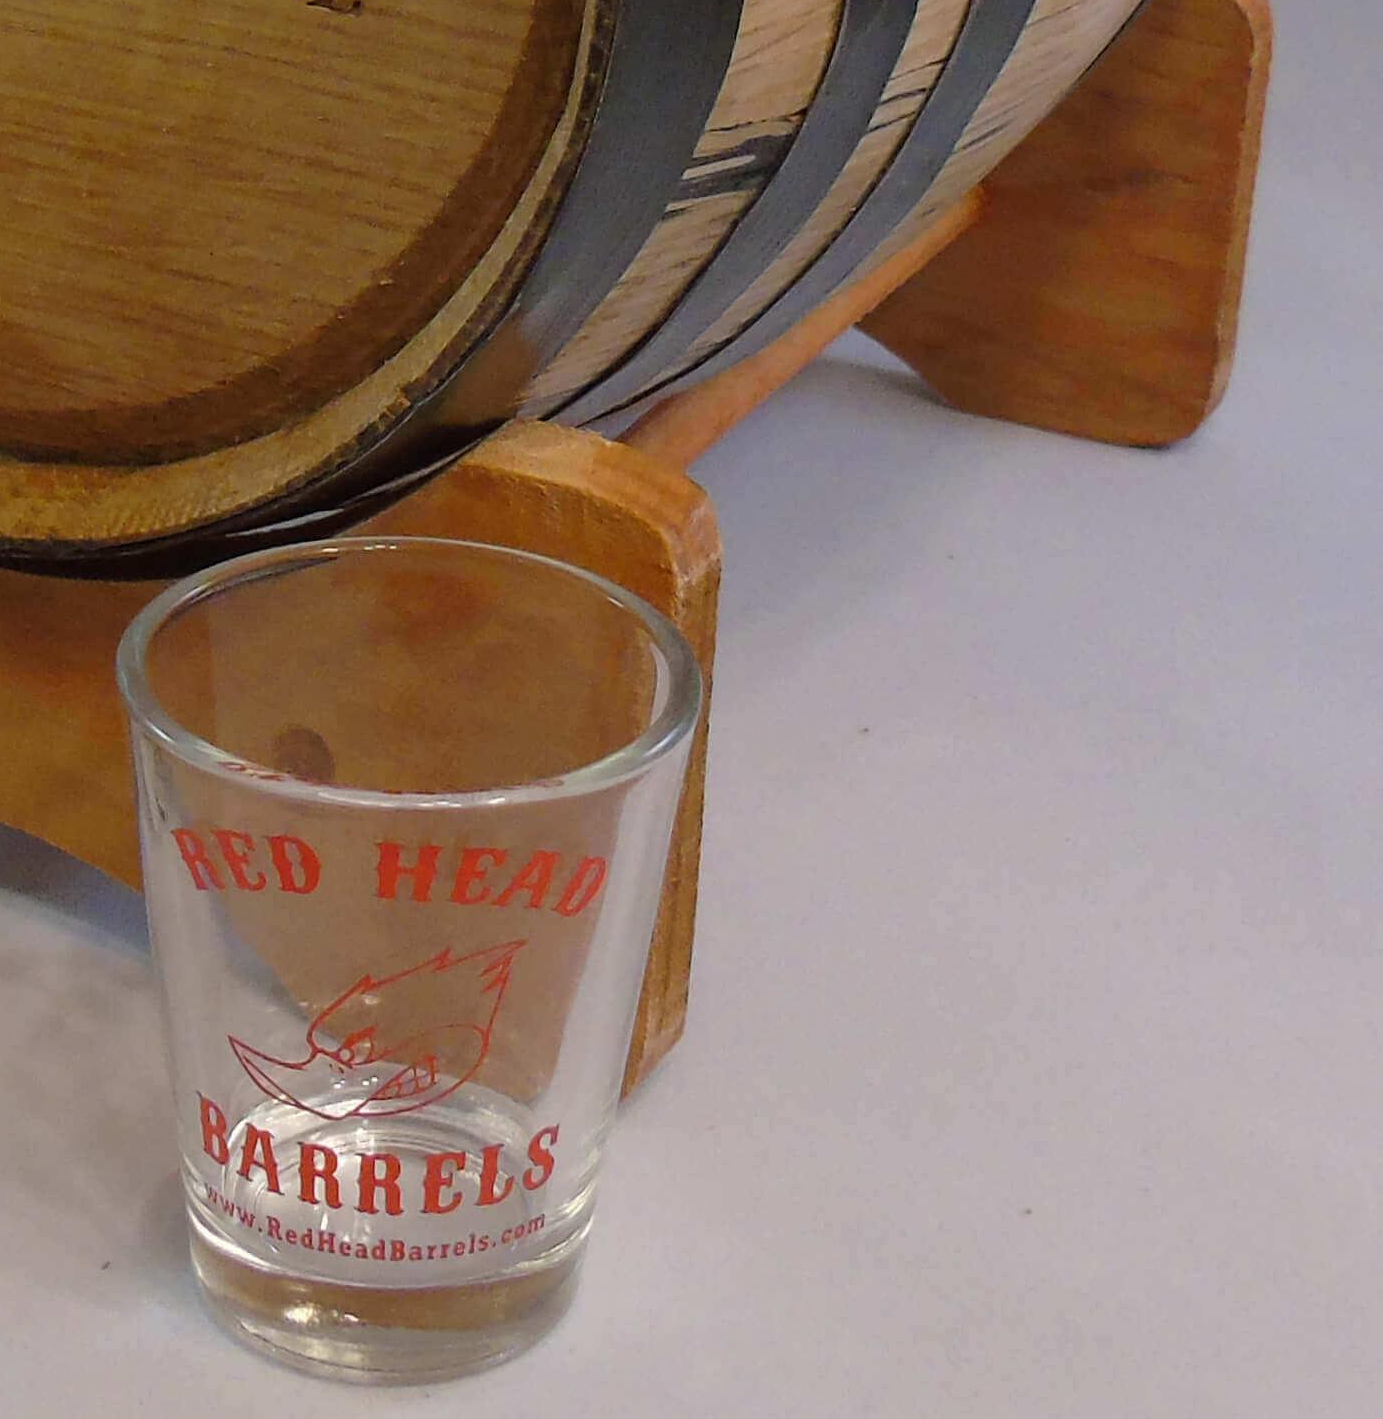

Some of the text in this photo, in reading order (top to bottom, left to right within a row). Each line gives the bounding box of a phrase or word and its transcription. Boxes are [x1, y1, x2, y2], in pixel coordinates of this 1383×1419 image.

[170, 828, 608, 918] RED HEAD
[196, 1090, 561, 1217] BARRELS
[205, 1183, 547, 1263] www.RedHeadBarrels.com
